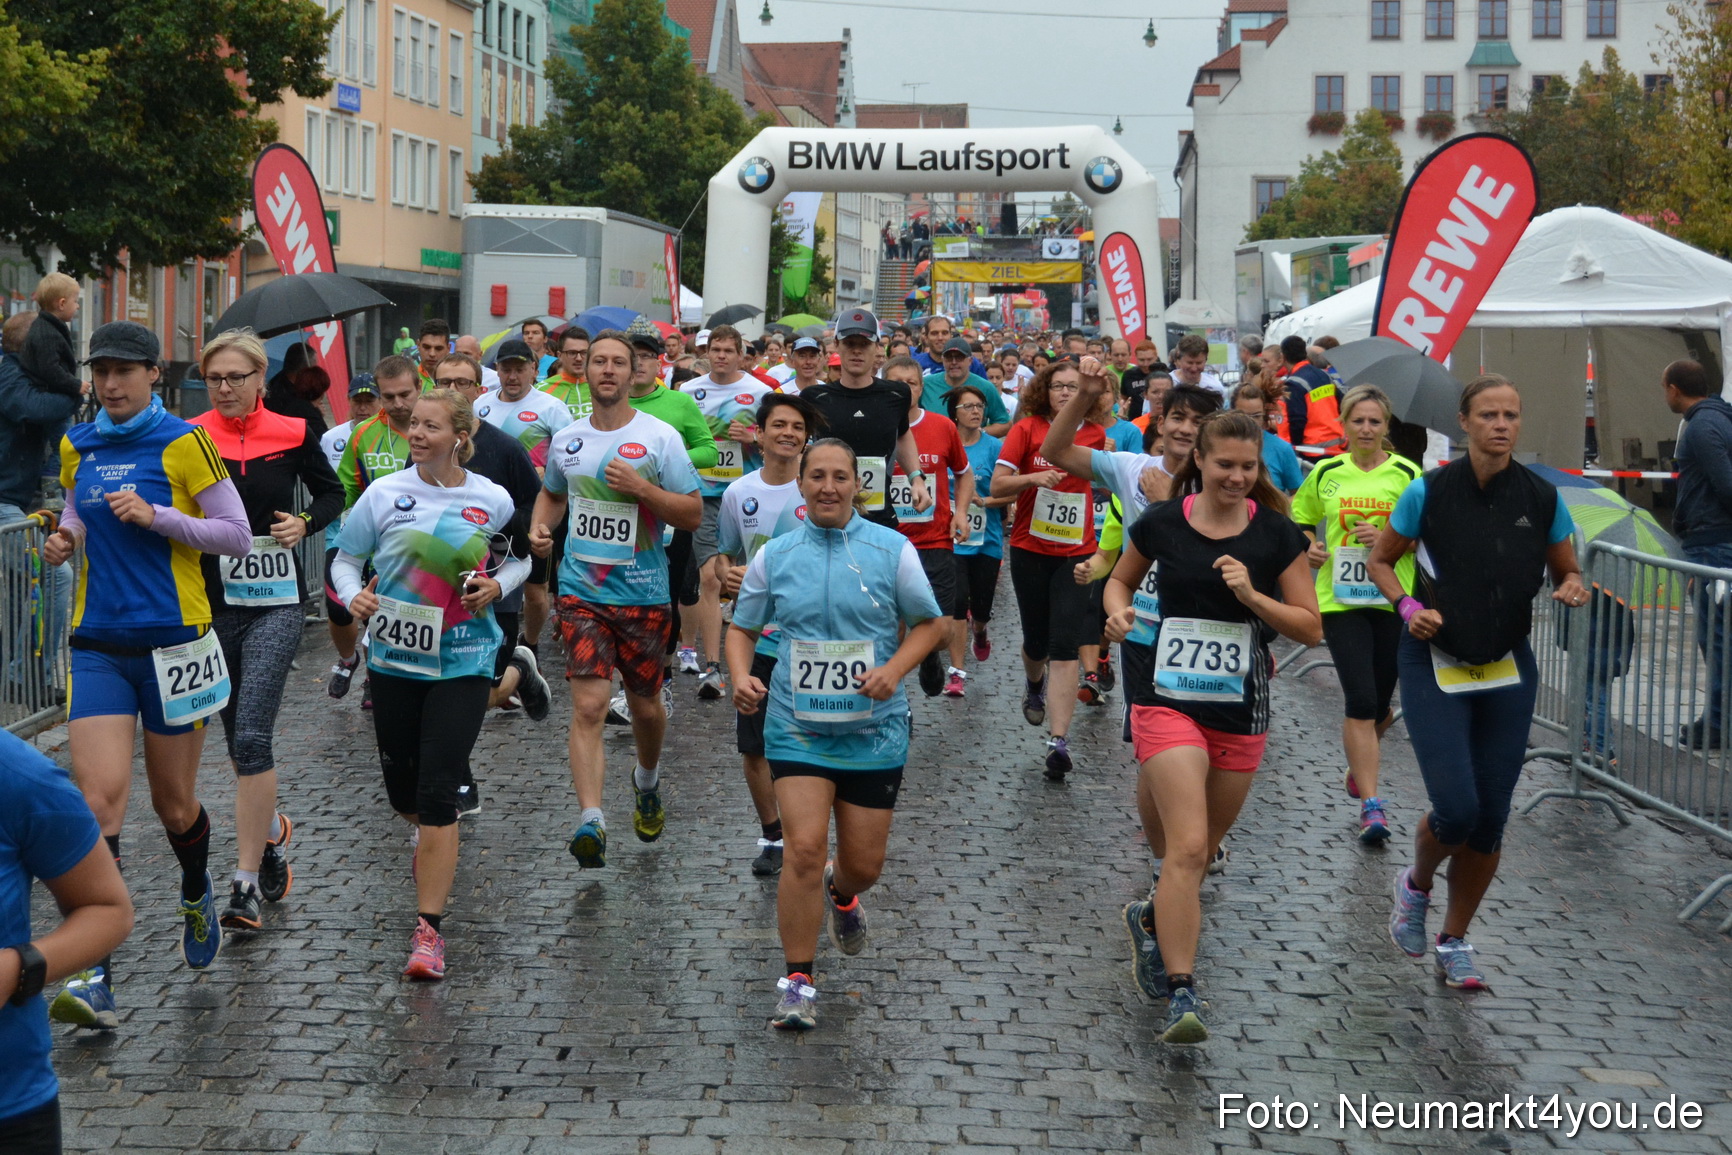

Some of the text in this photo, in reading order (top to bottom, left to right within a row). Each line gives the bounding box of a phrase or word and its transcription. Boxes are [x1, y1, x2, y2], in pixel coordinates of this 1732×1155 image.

[788, 141, 1070, 177] BMW Laufsport
[1388, 164, 1515, 356] REWE
[991, 266, 1024, 278] ZIEL
[621, 445, 645, 455] Hervis
[710, 467, 730, 476] Tobias
[598, 503, 632, 514] BOCK
[1339, 497, 1392, 510] Müller
[1047, 502, 1077, 525] 136
[576, 513, 631, 542] 3059
[1044, 525, 1071, 537] Kerstin
[228, 552, 289, 580] 2600
[1340, 560, 1374, 583] 20
[1137, 570, 1157, 595] 8
[247, 586, 274, 597] Petra
[1350, 587, 1380, 597] Monika
[400, 604, 436, 618] BOCK
[1134, 597, 1152, 611] Amir
[376, 614, 434, 651] 2430
[452, 625, 471, 639] 17.
[1200, 622, 1243, 636] BOCK
[824, 643, 866, 654] BOCK
[1166, 637, 1241, 673] 2733
[384, 649, 419, 664] Marika
[167, 648, 223, 696] 2241
[798, 660, 867, 690] 2739
[1469, 669, 1485, 680] Evi
[1176, 676, 1224, 691] Melanie
[191, 691, 217, 710] Cindy
[809, 697, 854, 710] Melanie
